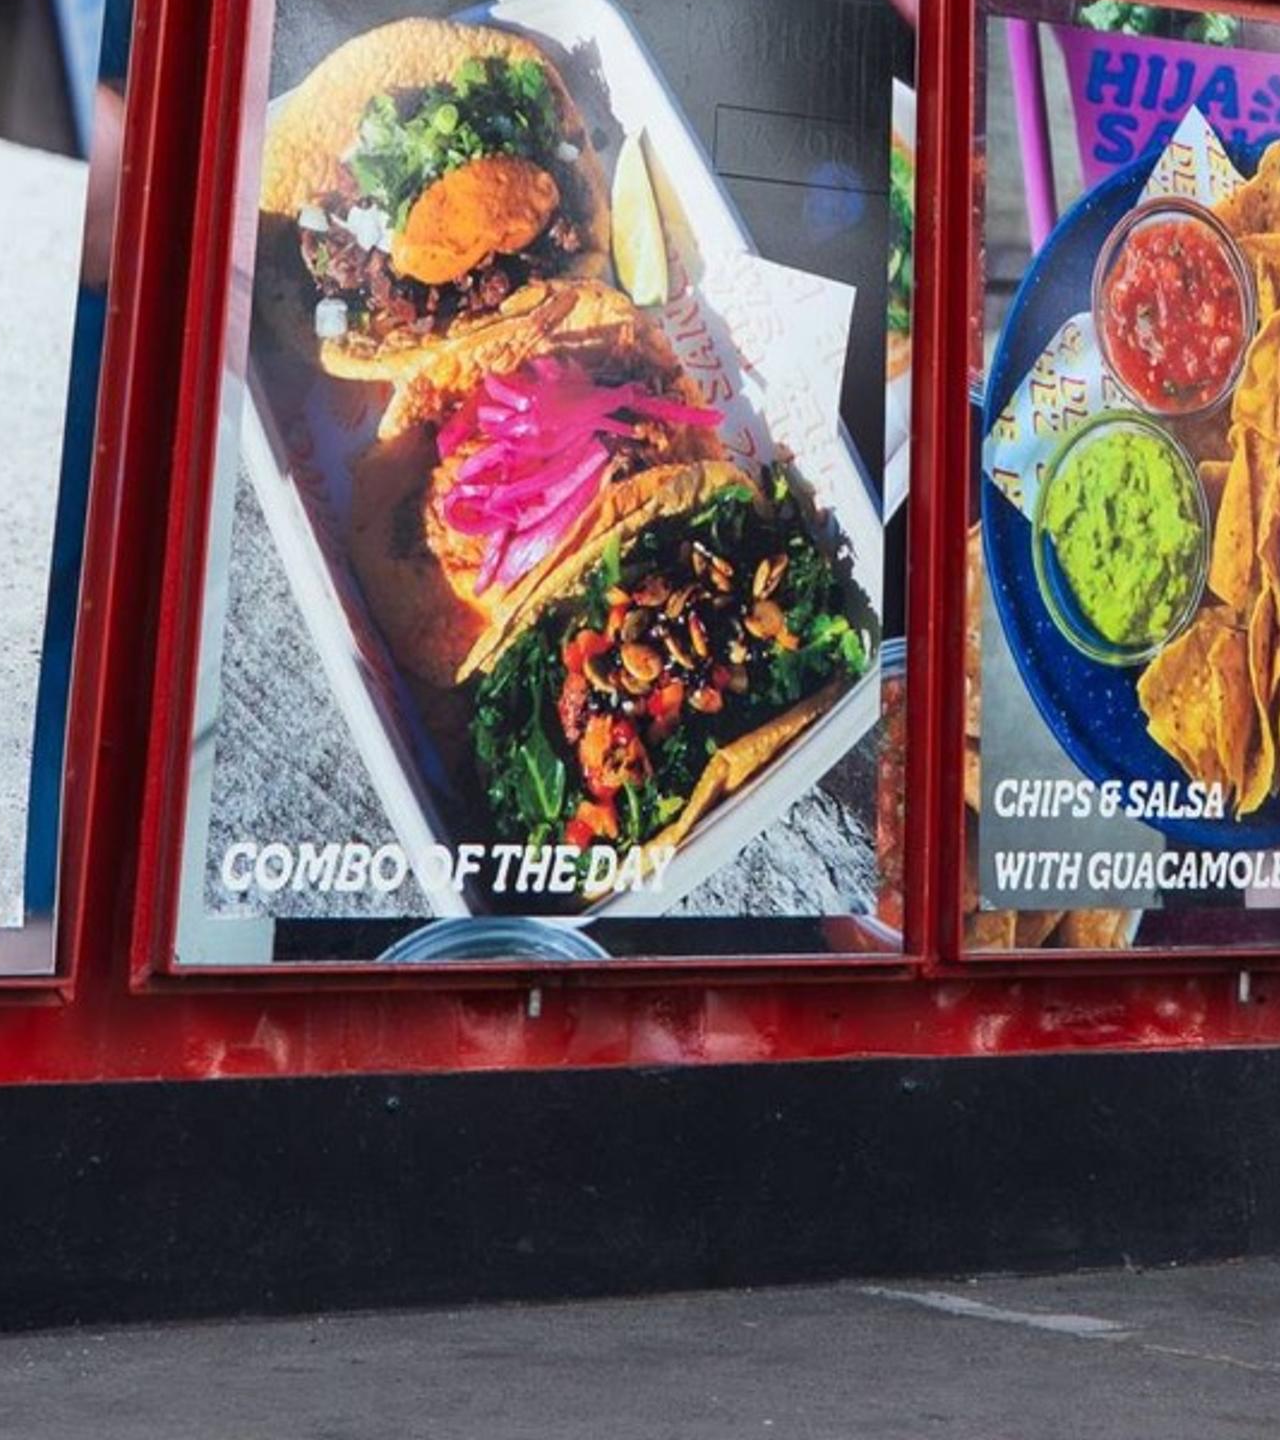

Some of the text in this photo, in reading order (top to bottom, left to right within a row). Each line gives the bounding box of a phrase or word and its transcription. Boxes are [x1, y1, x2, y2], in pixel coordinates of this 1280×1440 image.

[1085, 49, 1241, 120] HIJA
[993, 779, 1225, 819] CHIPS & SALSA
[221, 841, 679, 894] COMBO OF THE DAY
[994, 852, 1081, 890] WITH
